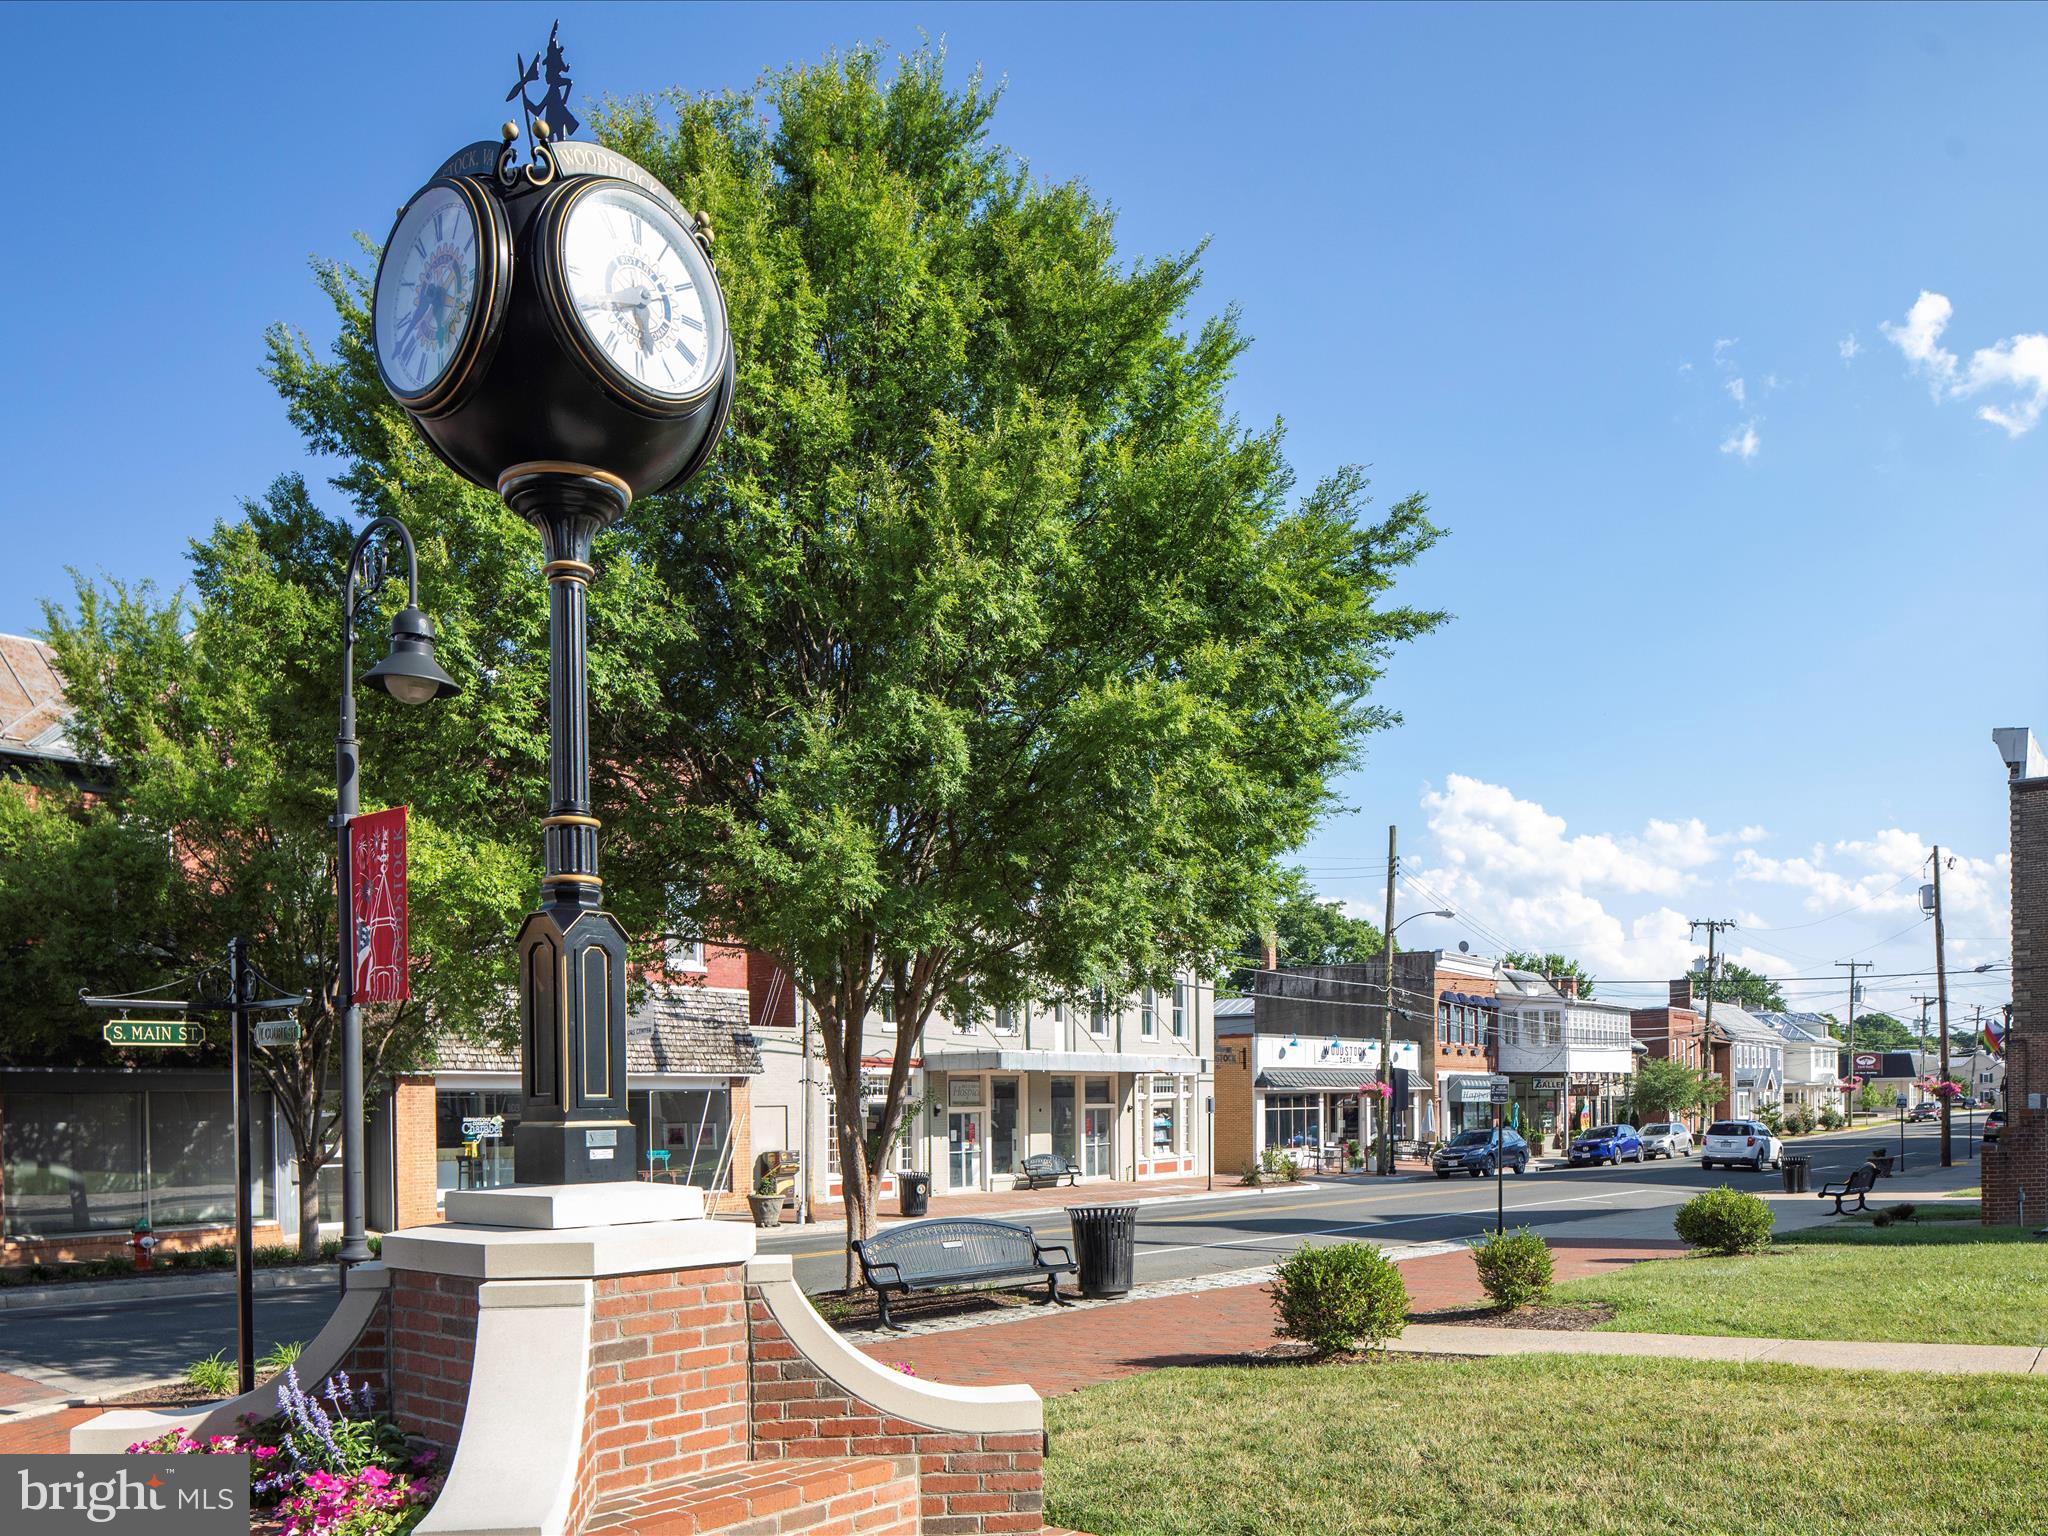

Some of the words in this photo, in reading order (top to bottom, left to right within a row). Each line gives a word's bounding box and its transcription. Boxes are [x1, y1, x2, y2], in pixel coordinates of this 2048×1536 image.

[392, 827, 404, 985] WOODSTOCK
[113, 1026, 126, 1040] S.
[131, 1026, 172, 1041] MAIN
[178, 1026, 198, 1041] ST.
[1322, 1045, 1367, 1057] WOODSTOCK
